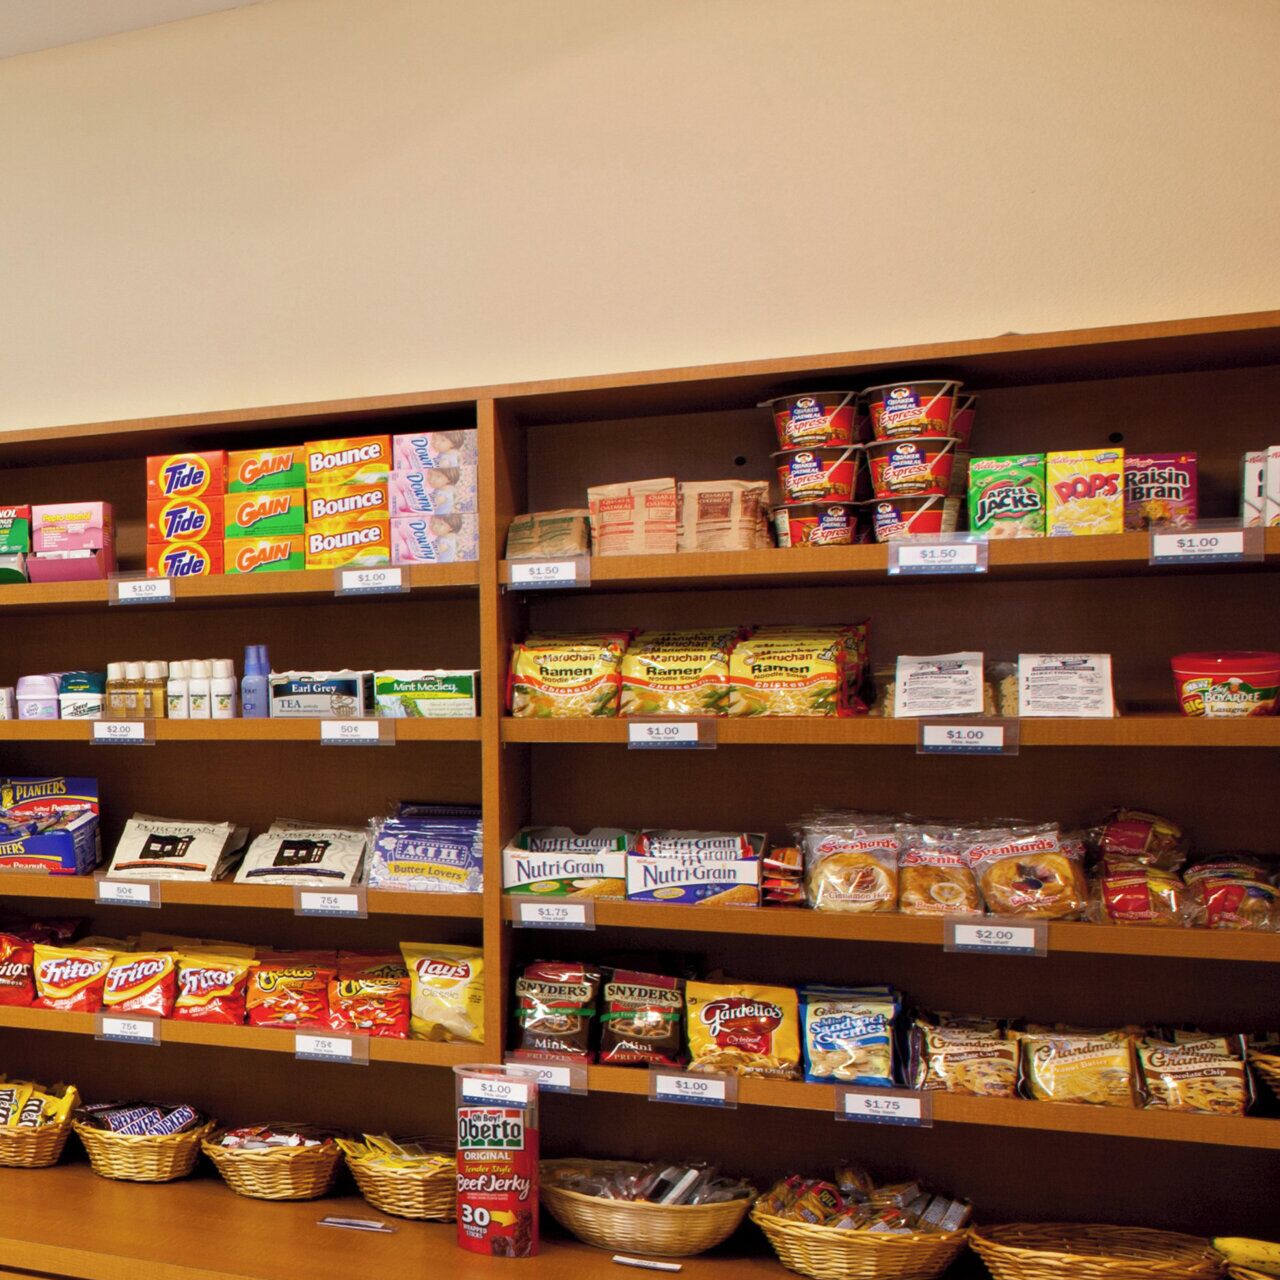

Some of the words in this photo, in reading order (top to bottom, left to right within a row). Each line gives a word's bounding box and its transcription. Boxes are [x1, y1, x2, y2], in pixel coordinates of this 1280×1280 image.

[880, 408, 925, 426] Express
[786, 417, 830, 433] Express
[309, 443, 382, 473] Bounce
[973, 460, 1012, 471] Kellogg's
[883, 463, 929, 482] Express
[1125, 467, 1189, 487] Raisin
[164, 464, 205, 495] Tide
[786, 472, 827, 489] Express
[410, 472, 433, 514] Downy
[988, 488, 1026, 499] APPLE
[1054, 473, 1121, 504] POPS
[1129, 484, 1184, 501] Bran
[311, 489, 384, 520] Bounce
[975, 493, 1040, 528] JACKS
[164, 507, 205, 538] Tide
[309, 525, 383, 554] Bounce
[411, 518, 435, 561] Downy
[809, 526, 850, 542] Express
[1177, 537, 1218, 549] $1.00
[920, 549, 957, 560] $1.50
[164, 550, 205, 577] Tide
[528, 565, 559, 576] $1.50
[358, 573, 385, 583] $1.00
[132, 584, 156, 593] $1.00
[543, 652, 596, 663] Maruchan
[650, 652, 707, 663] Maruchan
[540, 665, 593, 678] Ramen
[646, 665, 702, 677] Ramen
[751, 663, 810, 676] Ramen
[753, 671, 781, 680] Noodle
[292, 684, 310, 693] Earl
[313, 684, 337, 695] Grey
[394, 682, 417, 692] Mint
[418, 681, 459, 693] Medley
[541, 685, 590, 696] Chicken
[649, 682, 699, 691] Chicken
[754, 680, 806, 690] Chicken
[1204, 691, 1261, 703] BOYARDEE
[279, 699, 301, 709] TEA
[1184, 699, 1205, 713] BIG
[107, 725, 130, 734] $2.00
[341, 725, 358, 733] 50¢
[647, 727, 679, 736] $1.00
[946, 730, 984, 741] $1.00
[16, 780, 67, 800] PLANTERS
[405, 844, 441, 860] ACT
[445, 846, 458, 861] II
[969, 839, 1054, 862] Svenhard's
[393, 864, 425, 877] Butter
[429, 867, 463, 880] Lovers
[516, 859, 605, 885] Nutri-Grain
[643, 860, 737, 888] Nutri-Grain
[117, 887, 133, 895] 50¢
[321, 897, 338, 906] 75¢
[538, 907, 568, 917] $1.75
[976, 929, 1013, 940] $2.00
[40, 956, 103, 983] Fritos
[107, 956, 167, 992] Fritos
[419, 960, 470, 978] Lay's
[180, 967, 236, 996] Fritos
[421, 989, 459, 1000] Classic
[518, 980, 588, 997] SNYDER'S
[607, 984, 681, 1002] SNYDER'S
[121, 1022, 137, 1031] 75¢
[726, 1034, 762, 1046] Original
[815, 1024, 886, 1044] Cremes
[315, 1039, 332, 1048] 75¢
[534, 1039, 565, 1050] Mini
[621, 1041, 653, 1052] Mini
[1081, 1058, 1108, 1070] Butter
[1203, 1067, 1227, 1078] Chip
[480, 1083, 512, 1094] $1.00
[675, 1081, 708, 1092] $1.00
[864, 1099, 900, 1111] $1.75
[473, 1113, 482, 1122] Oh
[483, 1114, 503, 1125] Boy!
[459, 1118, 521, 1142] Oberto
[464, 1151, 511, 1161] ORIGINAL
[465, 1165, 490, 1174] Tender
[491, 1165, 512, 1175] Style
[457, 1173, 486, 1193] Beef
[485, 1173, 530, 1201] Jerky
[461, 1203, 491, 1227] 30
